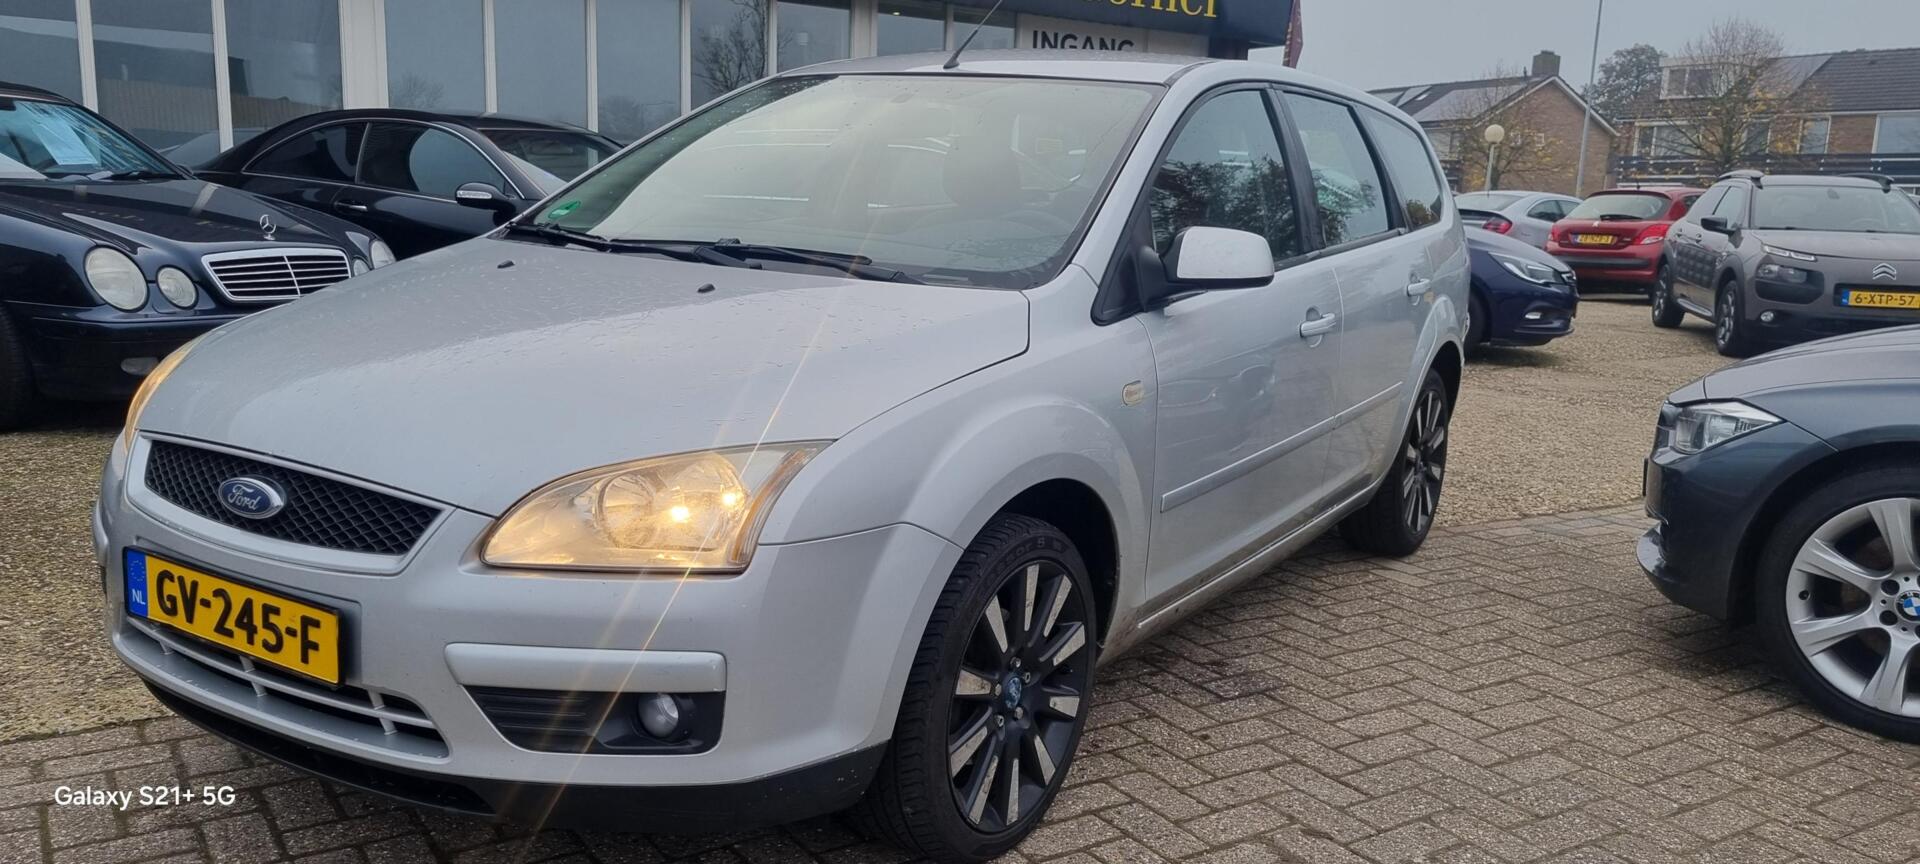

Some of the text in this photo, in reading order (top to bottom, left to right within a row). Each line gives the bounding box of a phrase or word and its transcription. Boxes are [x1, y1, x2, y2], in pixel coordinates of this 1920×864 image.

[1854, 293, 1916, 306] 6-XTP-57
[227, 484, 261, 510] Ford
[131, 588, 146, 605] NL
[156, 569, 321, 665] GV-245-F
